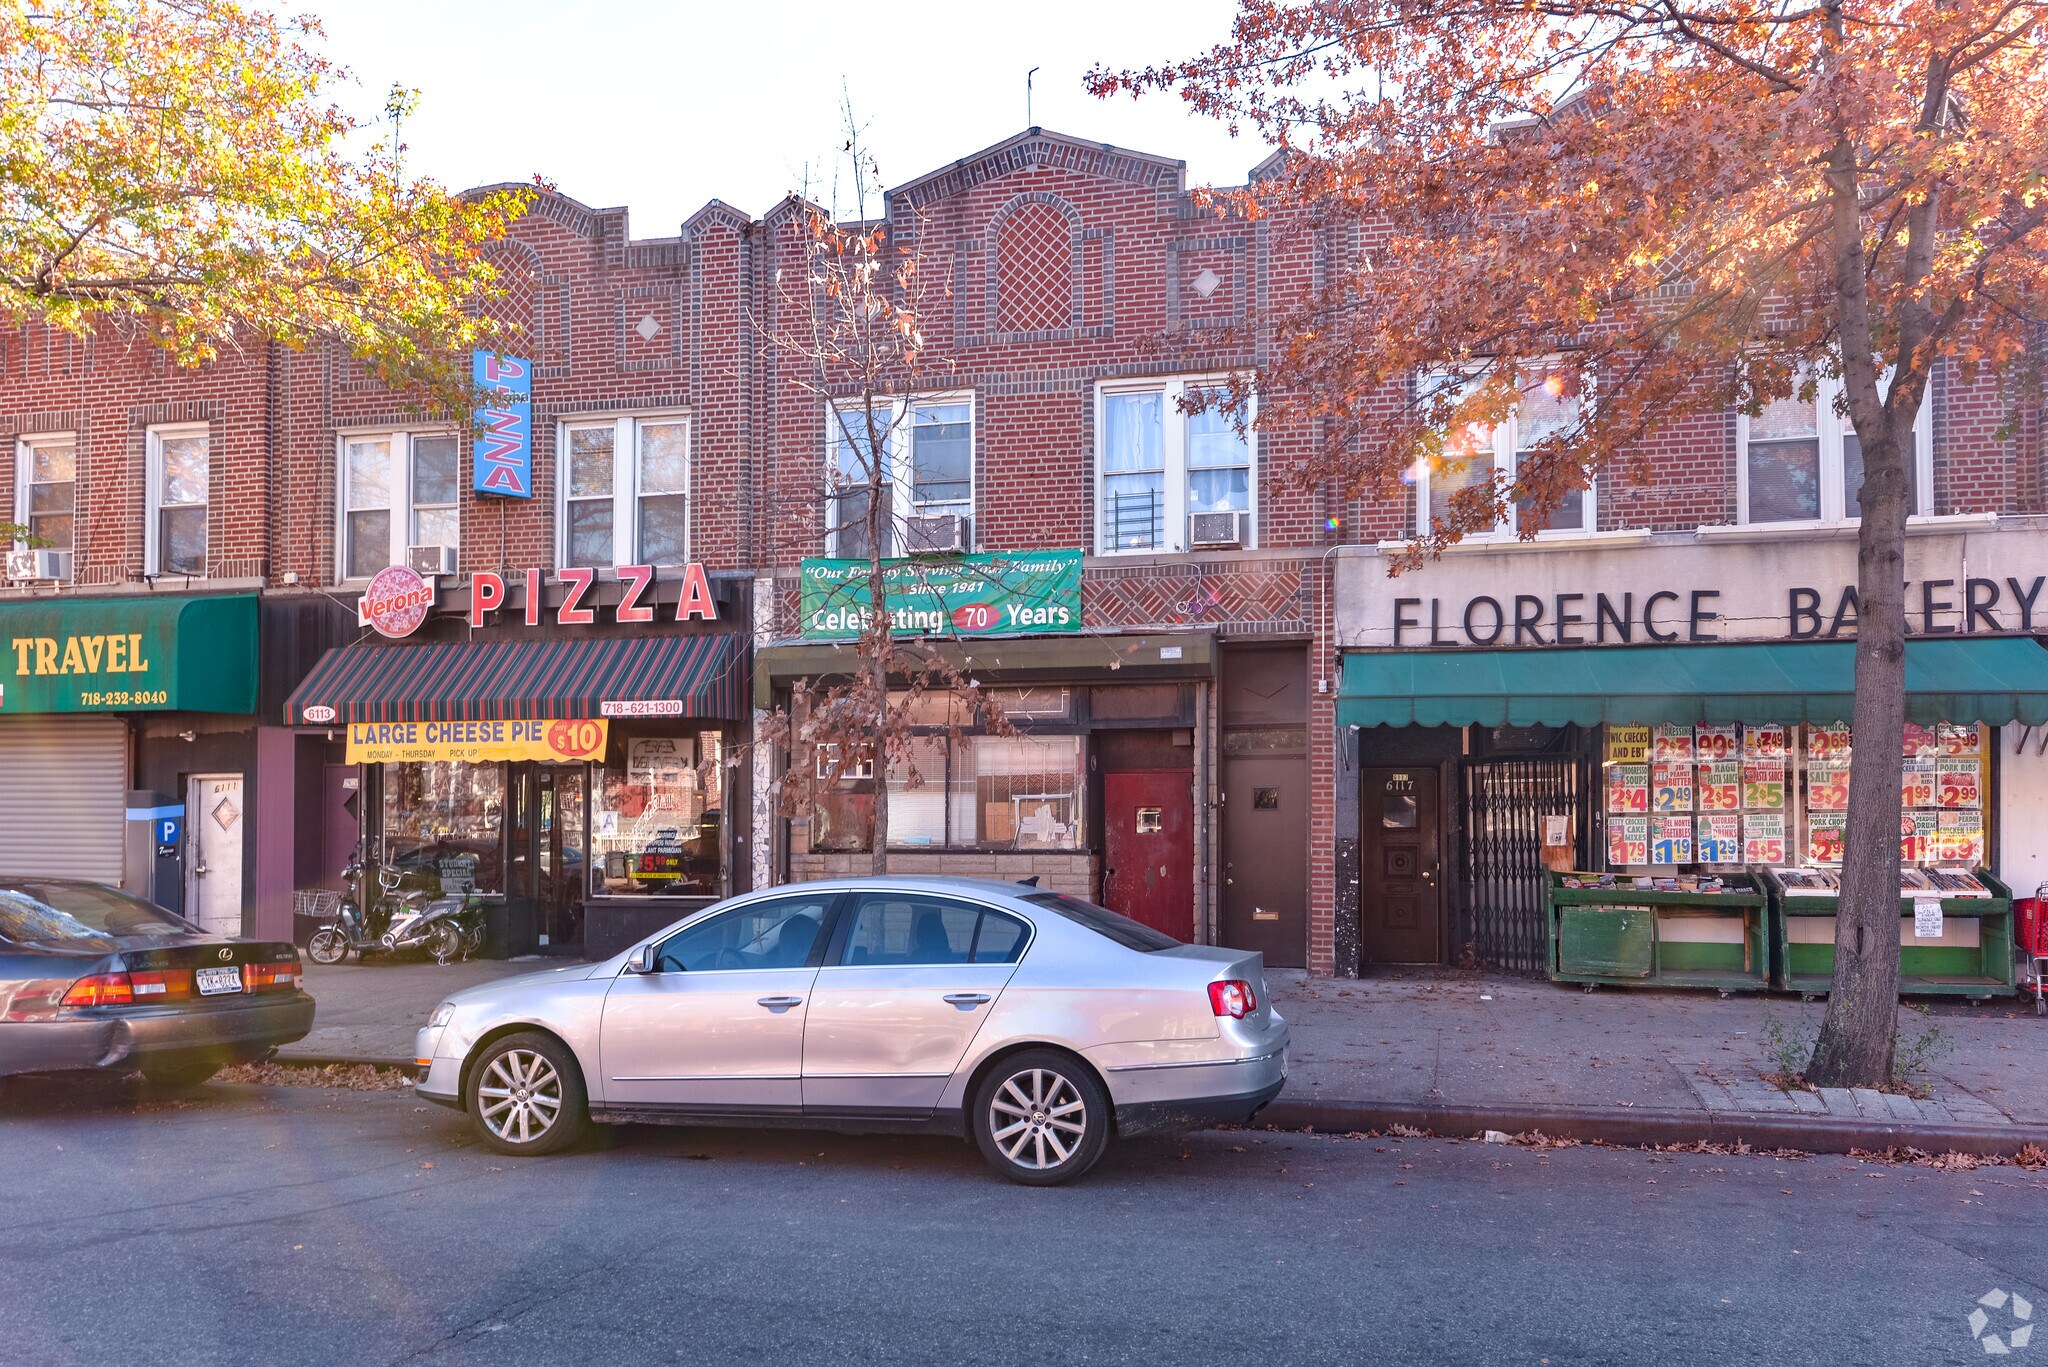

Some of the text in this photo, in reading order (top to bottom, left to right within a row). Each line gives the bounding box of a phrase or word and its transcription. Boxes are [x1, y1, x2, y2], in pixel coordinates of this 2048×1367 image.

[482, 355, 525, 493] PIZZA
[909, 582, 984, 595] Since 1941
[360, 562, 719, 628] Verona PIZZA
[812, 603, 1070, 634] Celebating 70 Years
[1394, 590, 1720, 647] FLORENCE
[12, 634, 148, 676] TRAVEL
[81, 690, 167, 706] 718-232-8040
[604, 702, 680, 714] 718-621-1300
[308, 708, 331, 720] 6113
[353, 721, 543, 745] LARGE CHEESE PIE
[555, 724, 567, 733] only
[1664, 727, 1692, 737] DRESSING
[557, 723, 597, 751] $10
[1624, 732, 1648, 744] CHECKS
[367, 750, 393, 759] MONDAY
[402, 750, 436, 758] THURSDAY
[449, 749, 465, 757] PICK
[468, 748, 478, 757] UP
[1612, 747, 1629, 758] AND
[1631, 747, 1646, 758] EBT
[1714, 763, 1736, 773] RAGU
[1757, 761, 1782, 771] BARILLA
[1809, 762, 1824, 771] RED
[1939, 764, 1977, 772] PORK RIBS
[1625, 776, 1647, 785] SOUPS
[1707, 774, 1739, 785] PASTA SAUCE
[1768, 771, 1784, 782] SAUCE
[1809, 771, 1832, 783] SALT
[214, 782, 238, 794] 6111
[1386, 780, 1413, 791] 6117
[1668, 778, 1692, 787] BUTTER
[603, 814, 615, 829] A
[1609, 818, 1647, 826] BETTY CROCKER
[1663, 819, 1691, 827] DEL MONTE
[1711, 816, 1737, 825] GATORADE
[164, 821, 176, 842] P
[1627, 825, 1645, 834] CAKE
[1660, 828, 1691, 839] VEGETABLES
[1712, 828, 1737, 838] DRINKS
[1760, 827, 1784, 836] TUNA
[1939, 827, 1980, 835] CHICKEN LEGS
[1625, 833, 1647, 842] MIXES
[666, 858, 679, 866] ONLY
[442, 868, 472, 878] SPECIAL
